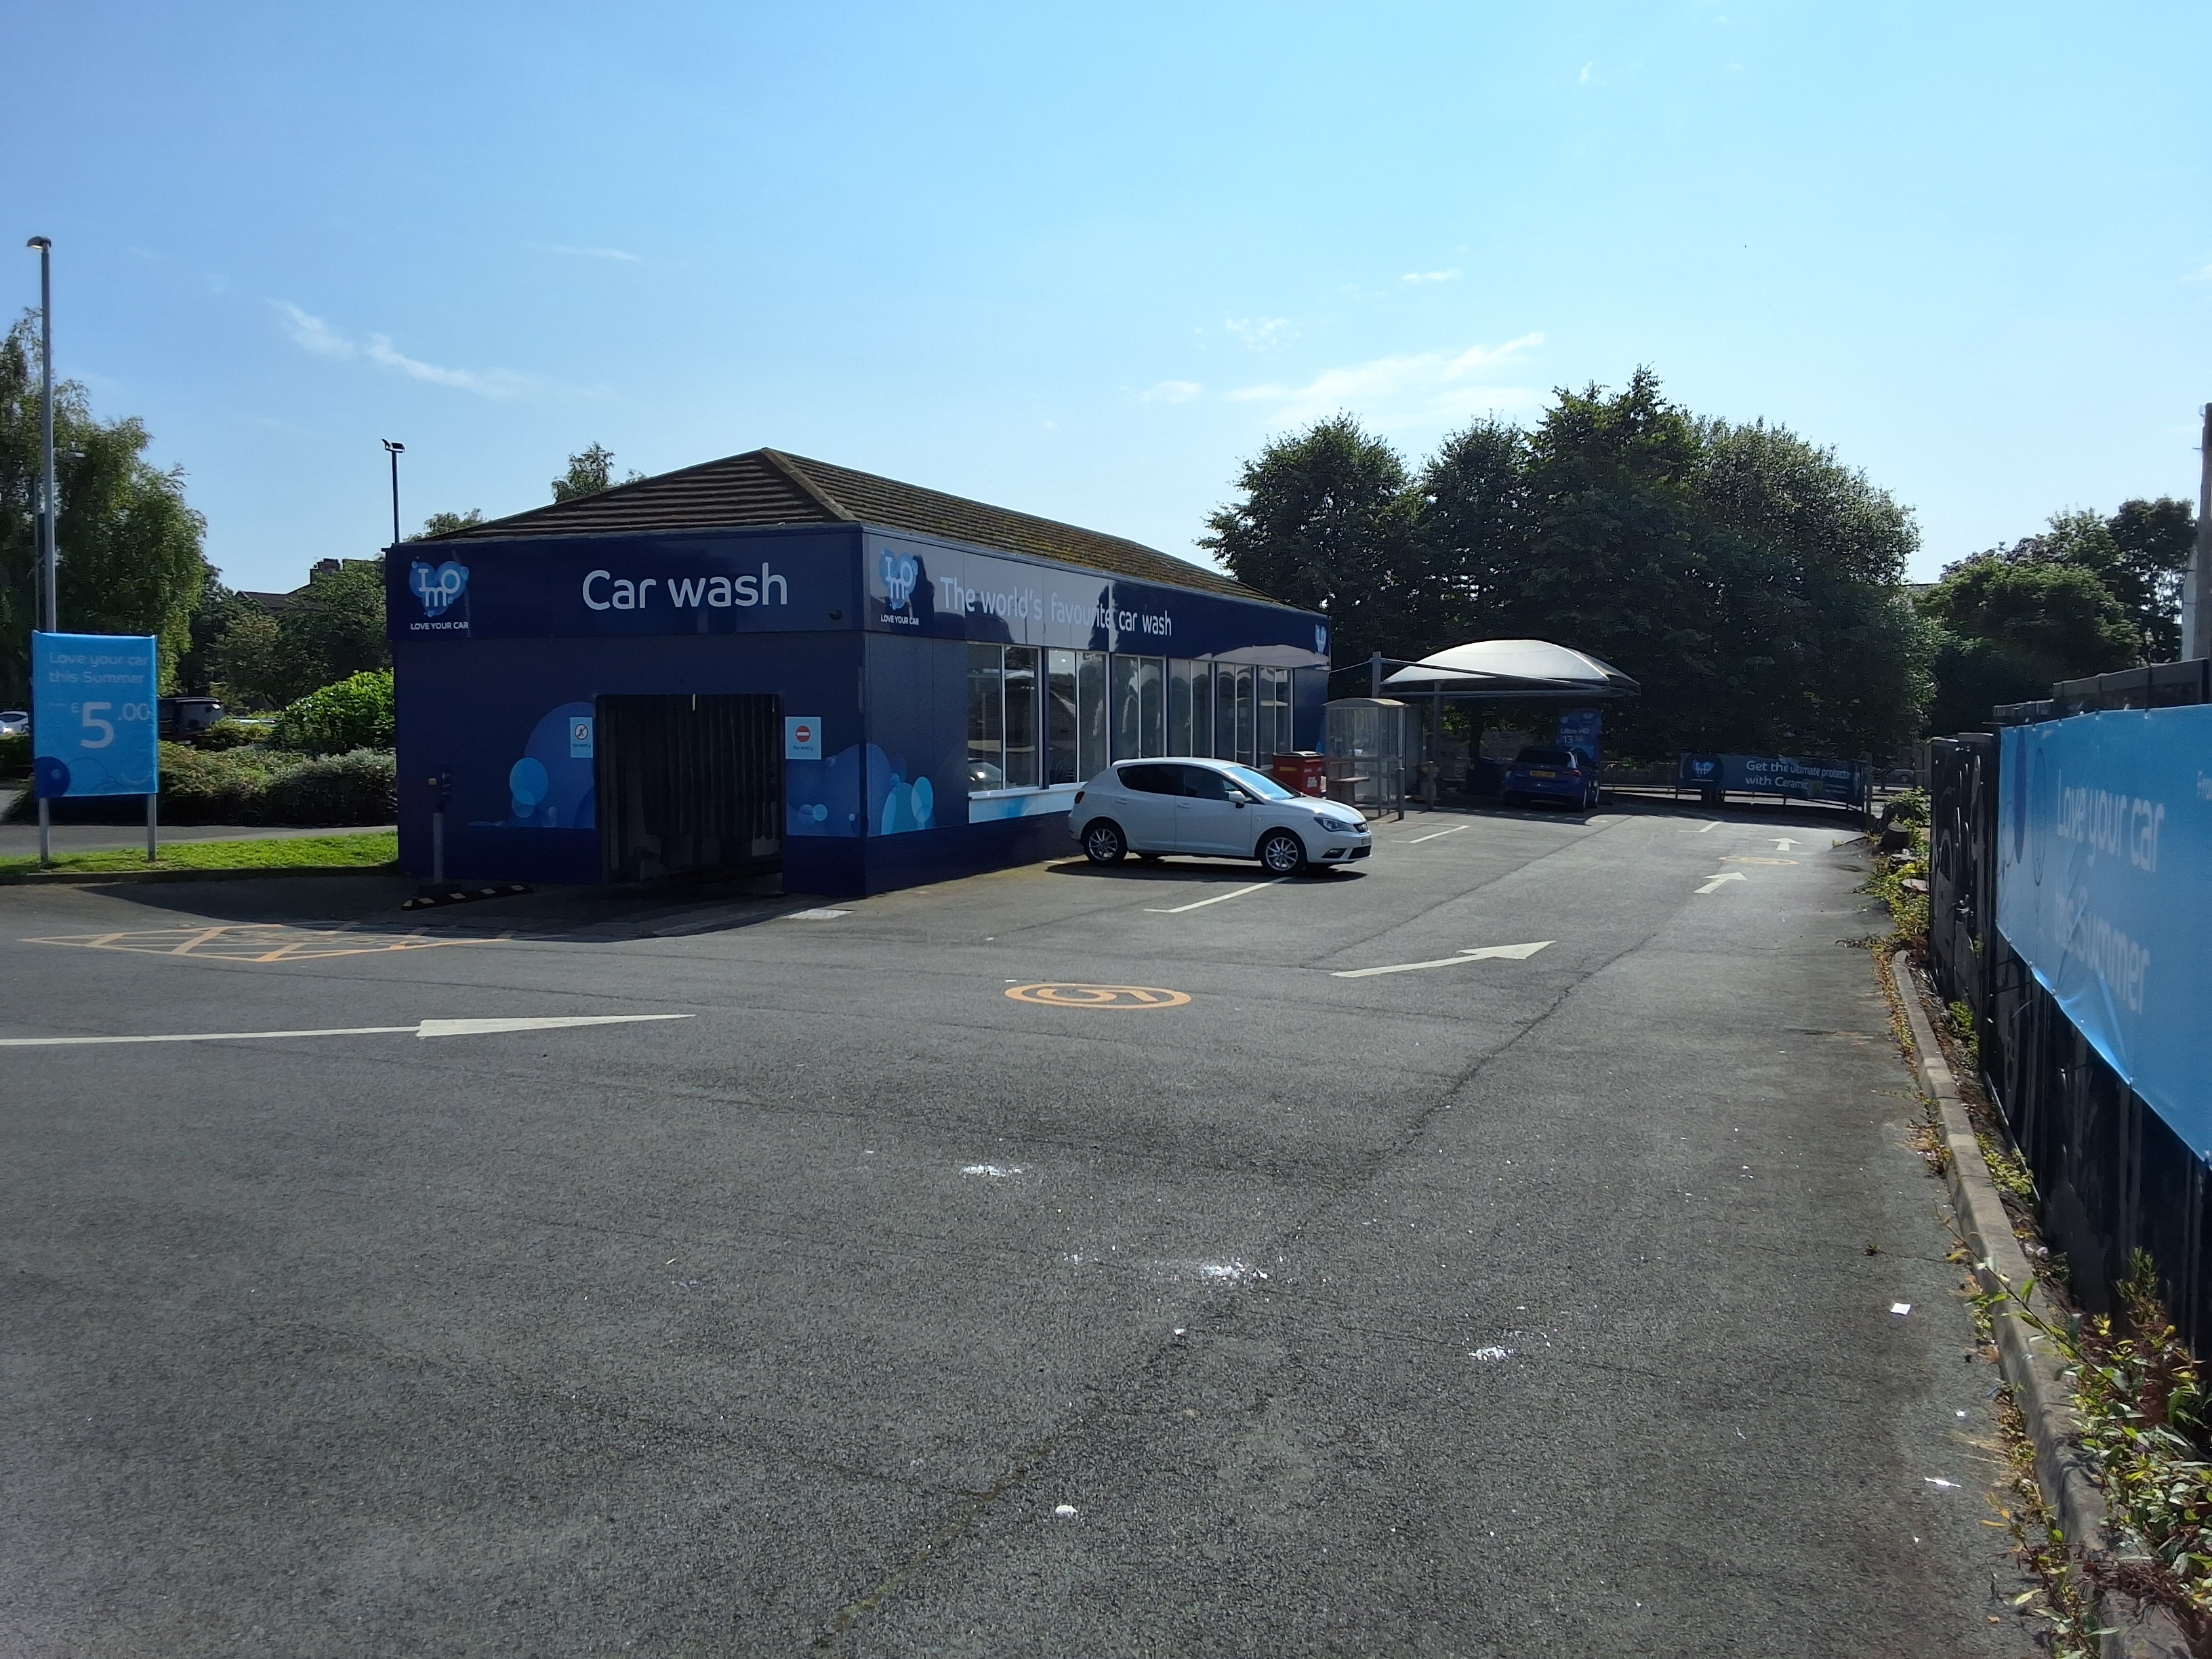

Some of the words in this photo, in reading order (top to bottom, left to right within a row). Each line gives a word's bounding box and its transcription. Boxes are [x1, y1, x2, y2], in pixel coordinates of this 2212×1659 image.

[582, 569, 657, 611] Car
[668, 562, 787, 608] wash
[940, 576, 975, 613] The
[981, 587, 1042, 621] world's
[1051, 592, 1110, 630] favourite
[1118, 609, 1138, 632] car
[1142, 611, 1172, 636] wash
[880, 614, 895, 623] LOVE
[895, 615, 909, 625] YOUR
[909, 617, 920, 626] CAR
[49, 653, 85, 664] Love
[90, 655, 124, 668] your
[127, 656, 149, 666] car
[49, 670, 79, 683] this
[83, 671, 145, 684] Summer
[1746, 760, 1767, 771] Get
[1770, 761, 1788, 773] the
[1790, 763, 1820, 777] ultimate
[1745, 775, 1771, 786] with
[1775, 776, 1809, 790] Ceramic
[2057, 769, 2086, 843] Love
[2087, 789, 2127, 867] your
[2130, 798, 2165, 873] car
